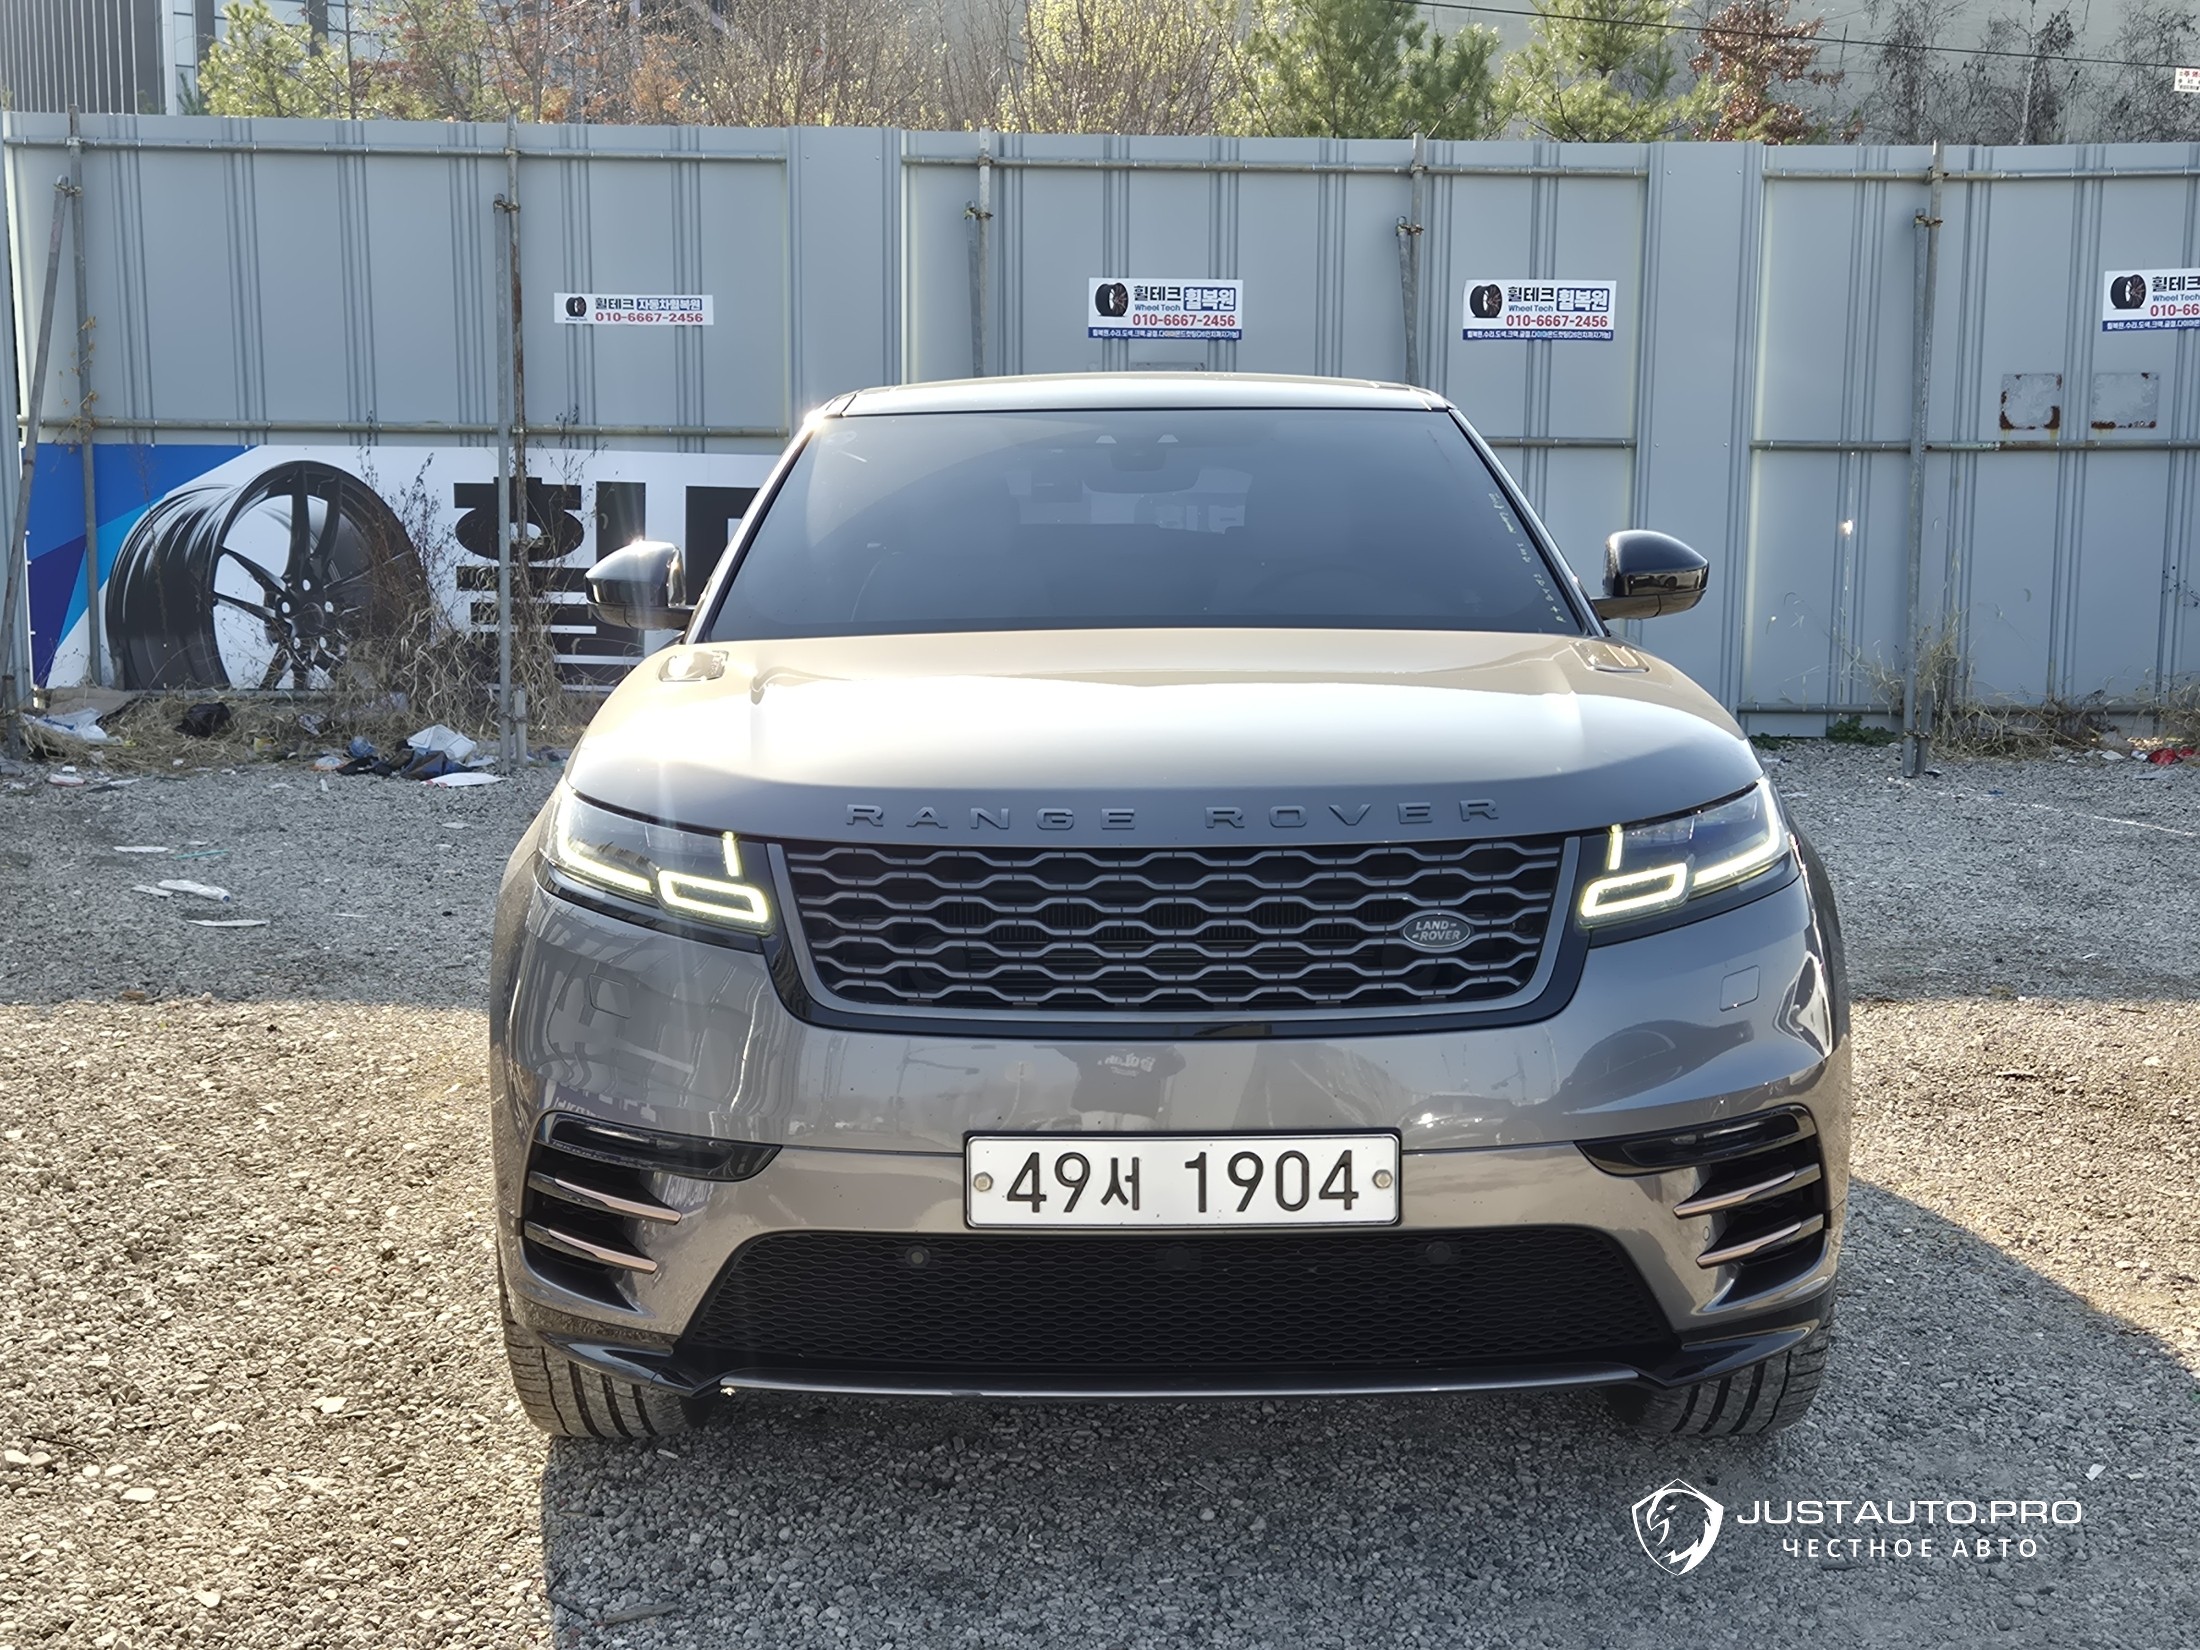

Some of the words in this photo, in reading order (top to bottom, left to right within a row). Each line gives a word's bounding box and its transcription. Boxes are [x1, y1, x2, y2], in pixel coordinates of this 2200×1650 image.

[595, 297, 635, 310] 휠테크
[1133, 285, 1182, 302] 휠테크
[1184, 288, 1236, 311] 휠복원
[1507, 286, 1555, 302] 휠테크
[1557, 289, 1609, 311] 휠복원
[2152, 294, 2179, 302] Wheel
[1134, 303, 1160, 311] Wheel
[1161, 304, 1181, 312] Tech
[1508, 304, 1533, 312] Wheel
[1534, 304, 1553, 312] Tech
[595, 312, 703, 323] 010-6667-2456
[1132, 314, 1236, 327] 010-6667-2456
[1506, 315, 1608, 327] 010-6667-2456
[846, 804, 1135, 830] RANGE
[1205, 799, 1499, 829] ROVER
[1006, 1151, 1140, 1213] 49서
[1184, 1149, 1360, 1213] 1904
